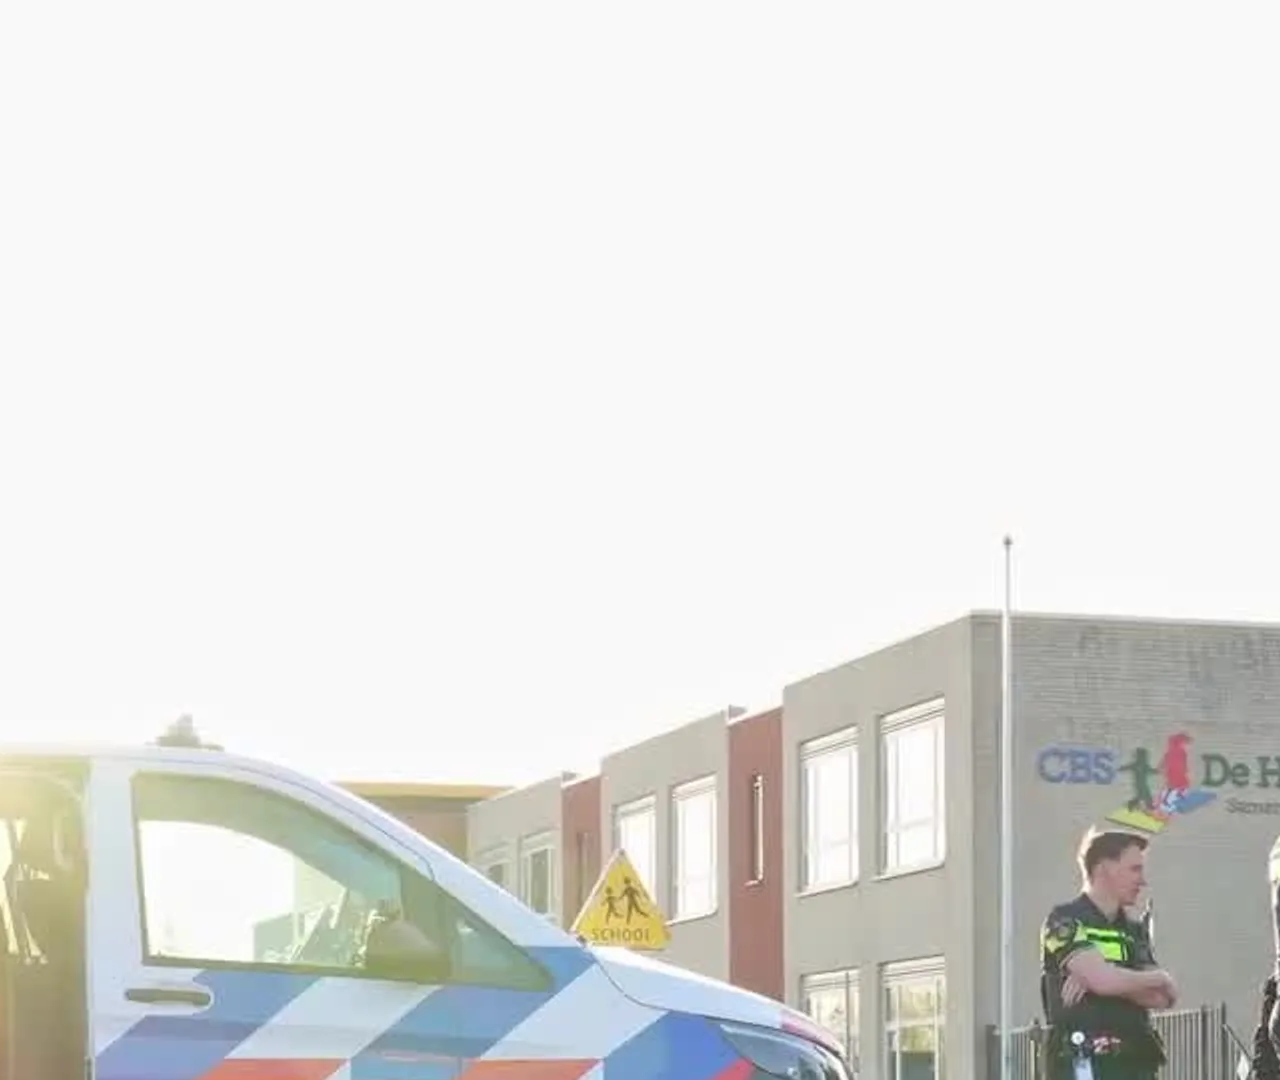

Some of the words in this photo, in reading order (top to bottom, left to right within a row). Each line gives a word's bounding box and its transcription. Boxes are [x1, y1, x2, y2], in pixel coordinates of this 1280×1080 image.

[1037, 749, 1116, 785] CBS
[1201, 753, 1250, 787] De
[591, 927, 650, 942] SCHOOL
